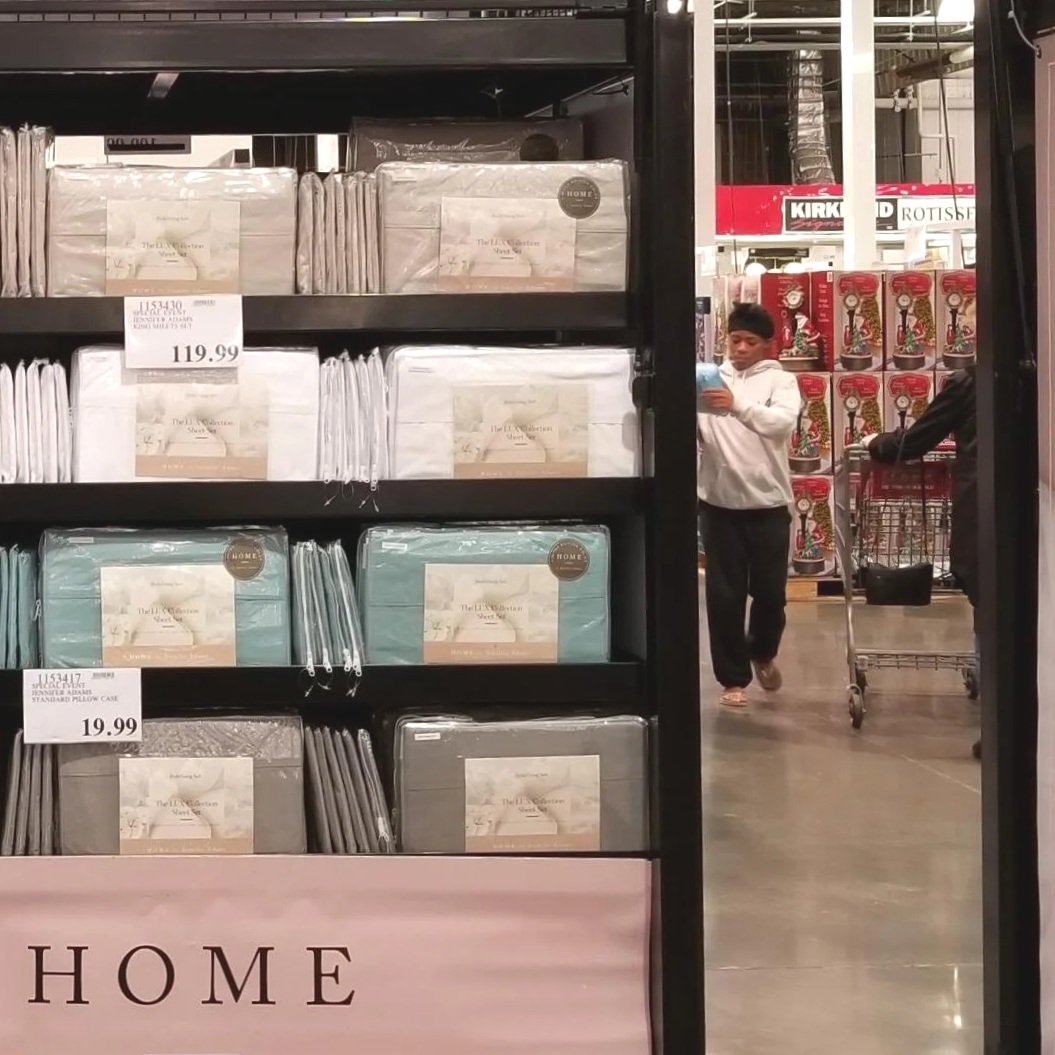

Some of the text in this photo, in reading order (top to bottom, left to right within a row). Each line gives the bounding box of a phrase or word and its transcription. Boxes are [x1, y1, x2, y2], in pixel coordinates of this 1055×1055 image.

[790, 201, 894, 219] KIRKD
[173, 344, 239, 363] 119.99
[37, 673, 82, 684] 1153417
[82, 717, 138, 736] 19.99
[27, 945, 355, 1006] HOME
